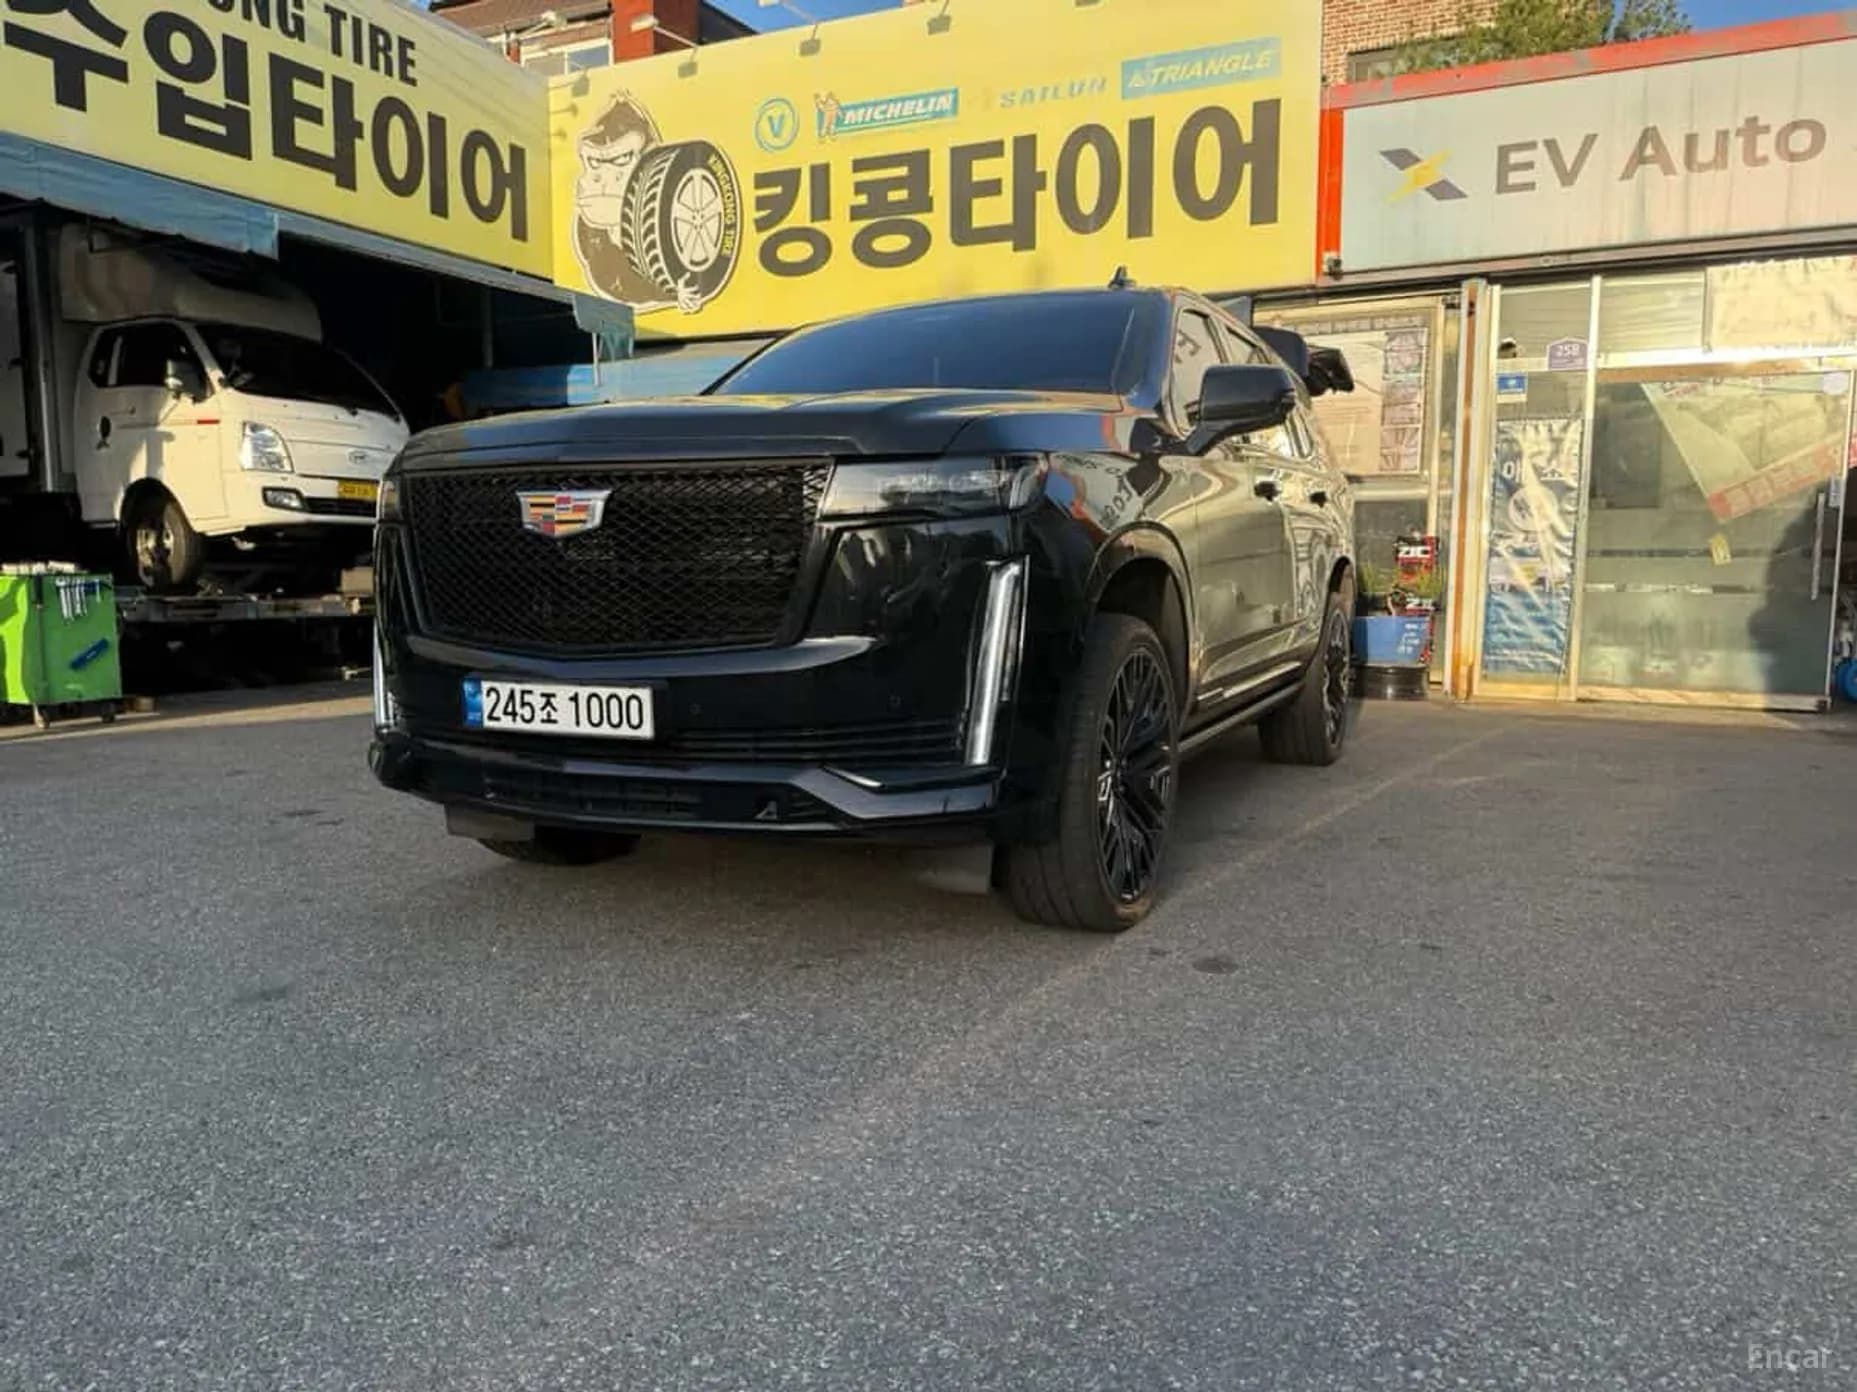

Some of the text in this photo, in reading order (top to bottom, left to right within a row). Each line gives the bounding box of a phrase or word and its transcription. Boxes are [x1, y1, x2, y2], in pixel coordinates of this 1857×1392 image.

[208, 0, 418, 87] NG TIRE
[1150, 49, 1272, 86] TRIANGLE
[2, 0, 529, 243] 수입타이어
[843, 94, 956, 125] MICHELIN
[753, 97, 1283, 278] 킹콩타이어
[1495, 115, 1827, 195] EV Auto
[485, 686, 644, 730] 245조 1000
